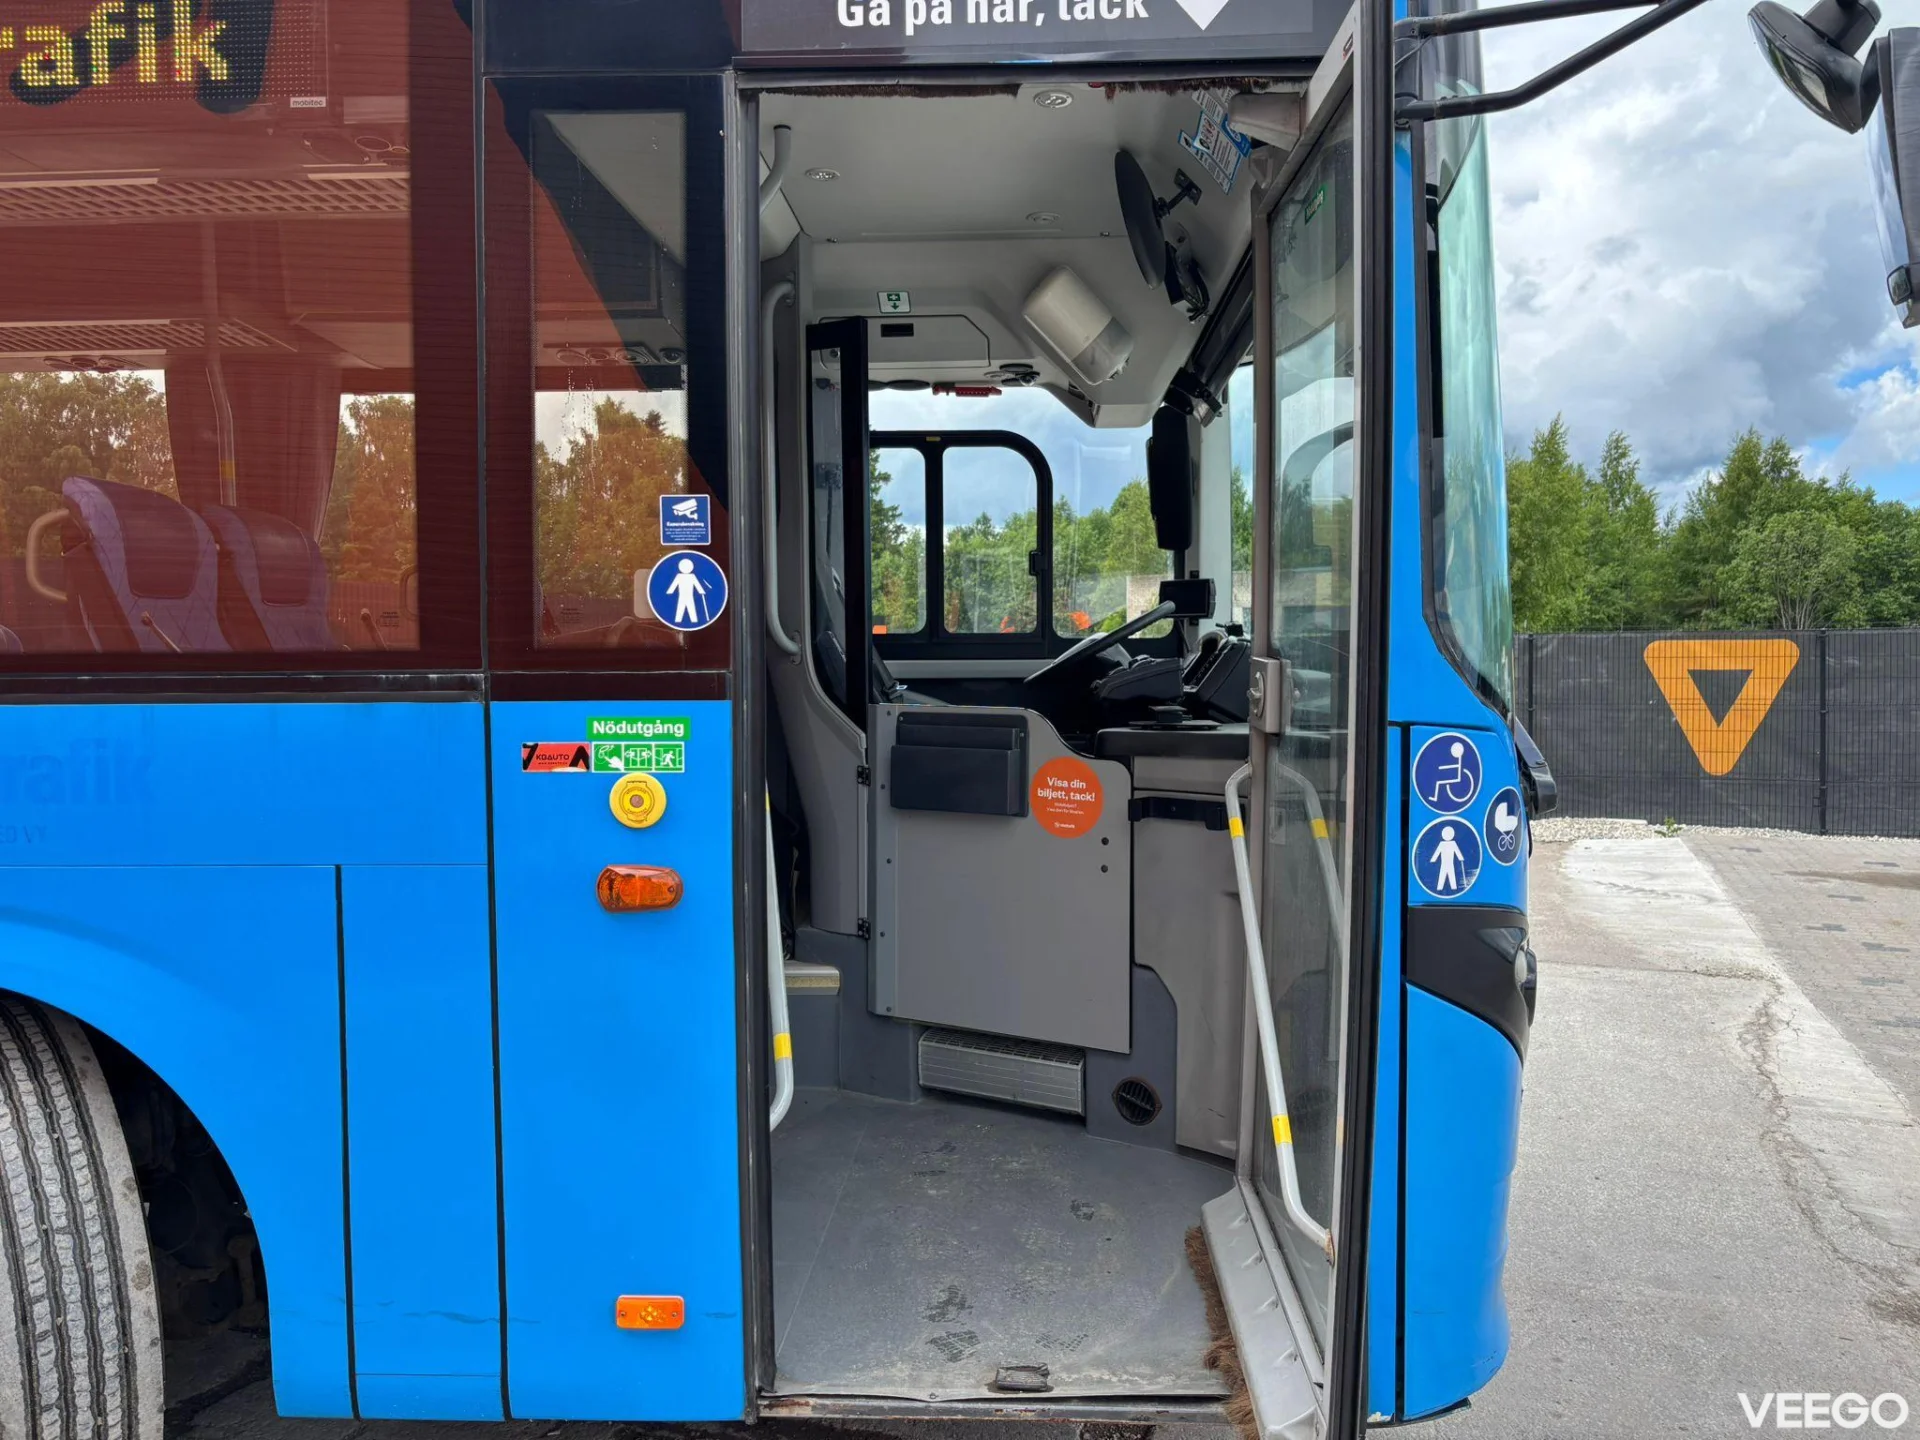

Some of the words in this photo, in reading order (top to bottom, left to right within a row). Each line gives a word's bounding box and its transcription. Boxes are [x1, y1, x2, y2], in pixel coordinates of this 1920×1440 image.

[0, 0, 229, 86] afik
[592, 720, 685, 737] Nödutgång
[1046, 776, 1069, 788] Visa
[1070, 779, 1087, 789] din
[1037, 787, 1069, 801] biljett,
[1070, 791, 1096, 802] tack!
